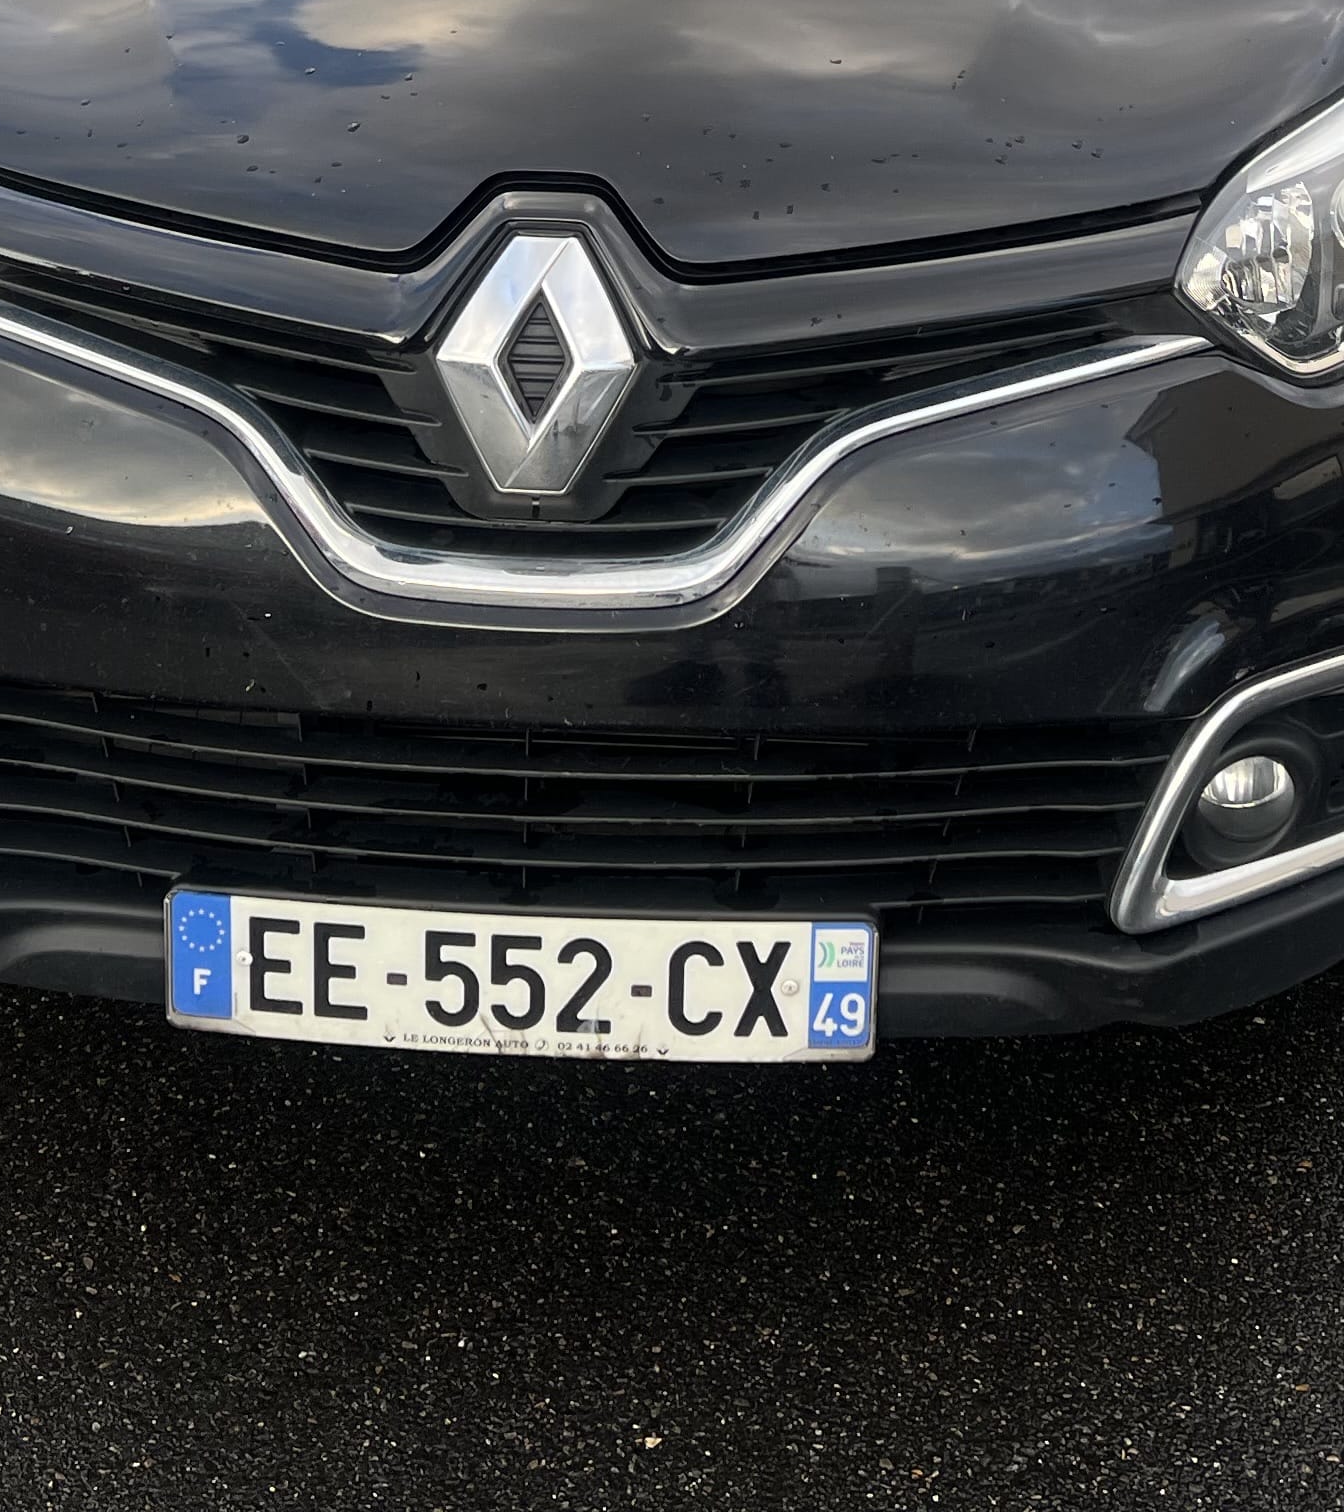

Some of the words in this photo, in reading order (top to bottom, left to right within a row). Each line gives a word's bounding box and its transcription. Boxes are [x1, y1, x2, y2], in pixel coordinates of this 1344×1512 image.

[193, 967, 212, 996] F
[249, 915, 792, 1038] EE-552-CX
[813, 992, 866, 1037] 49
[403, 1033, 419, 1044] LE
[423, 1035, 491, 1048] LONGERON
[495, 1039, 529, 1050] AUTO
[557, 1041, 573, 1051] 02
[576, 1043, 591, 1052] 41
